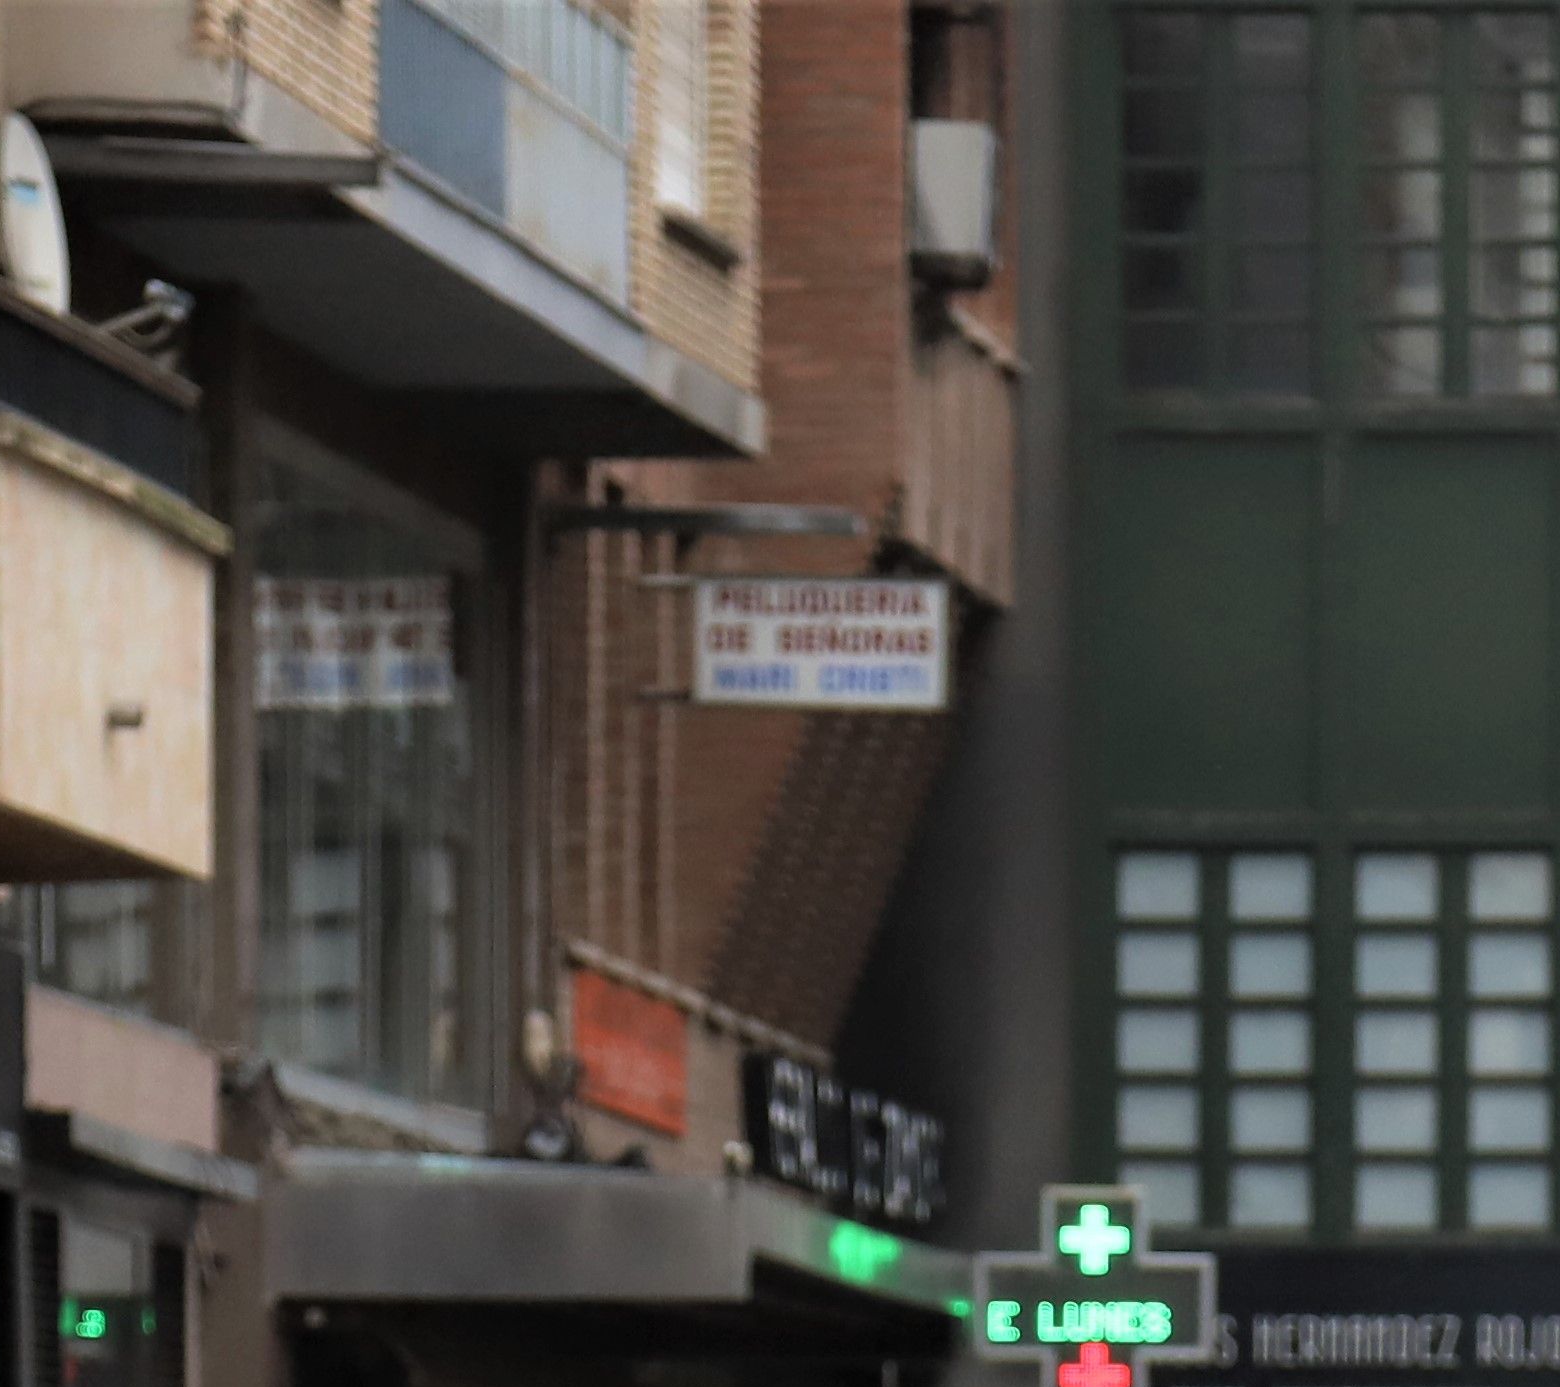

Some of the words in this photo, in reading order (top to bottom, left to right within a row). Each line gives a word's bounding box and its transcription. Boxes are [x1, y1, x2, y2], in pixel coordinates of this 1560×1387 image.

[708, 624, 748, 653] DE
[988, 1301, 1021, 1342] E
[1038, 1301, 1172, 1343] LUNES
